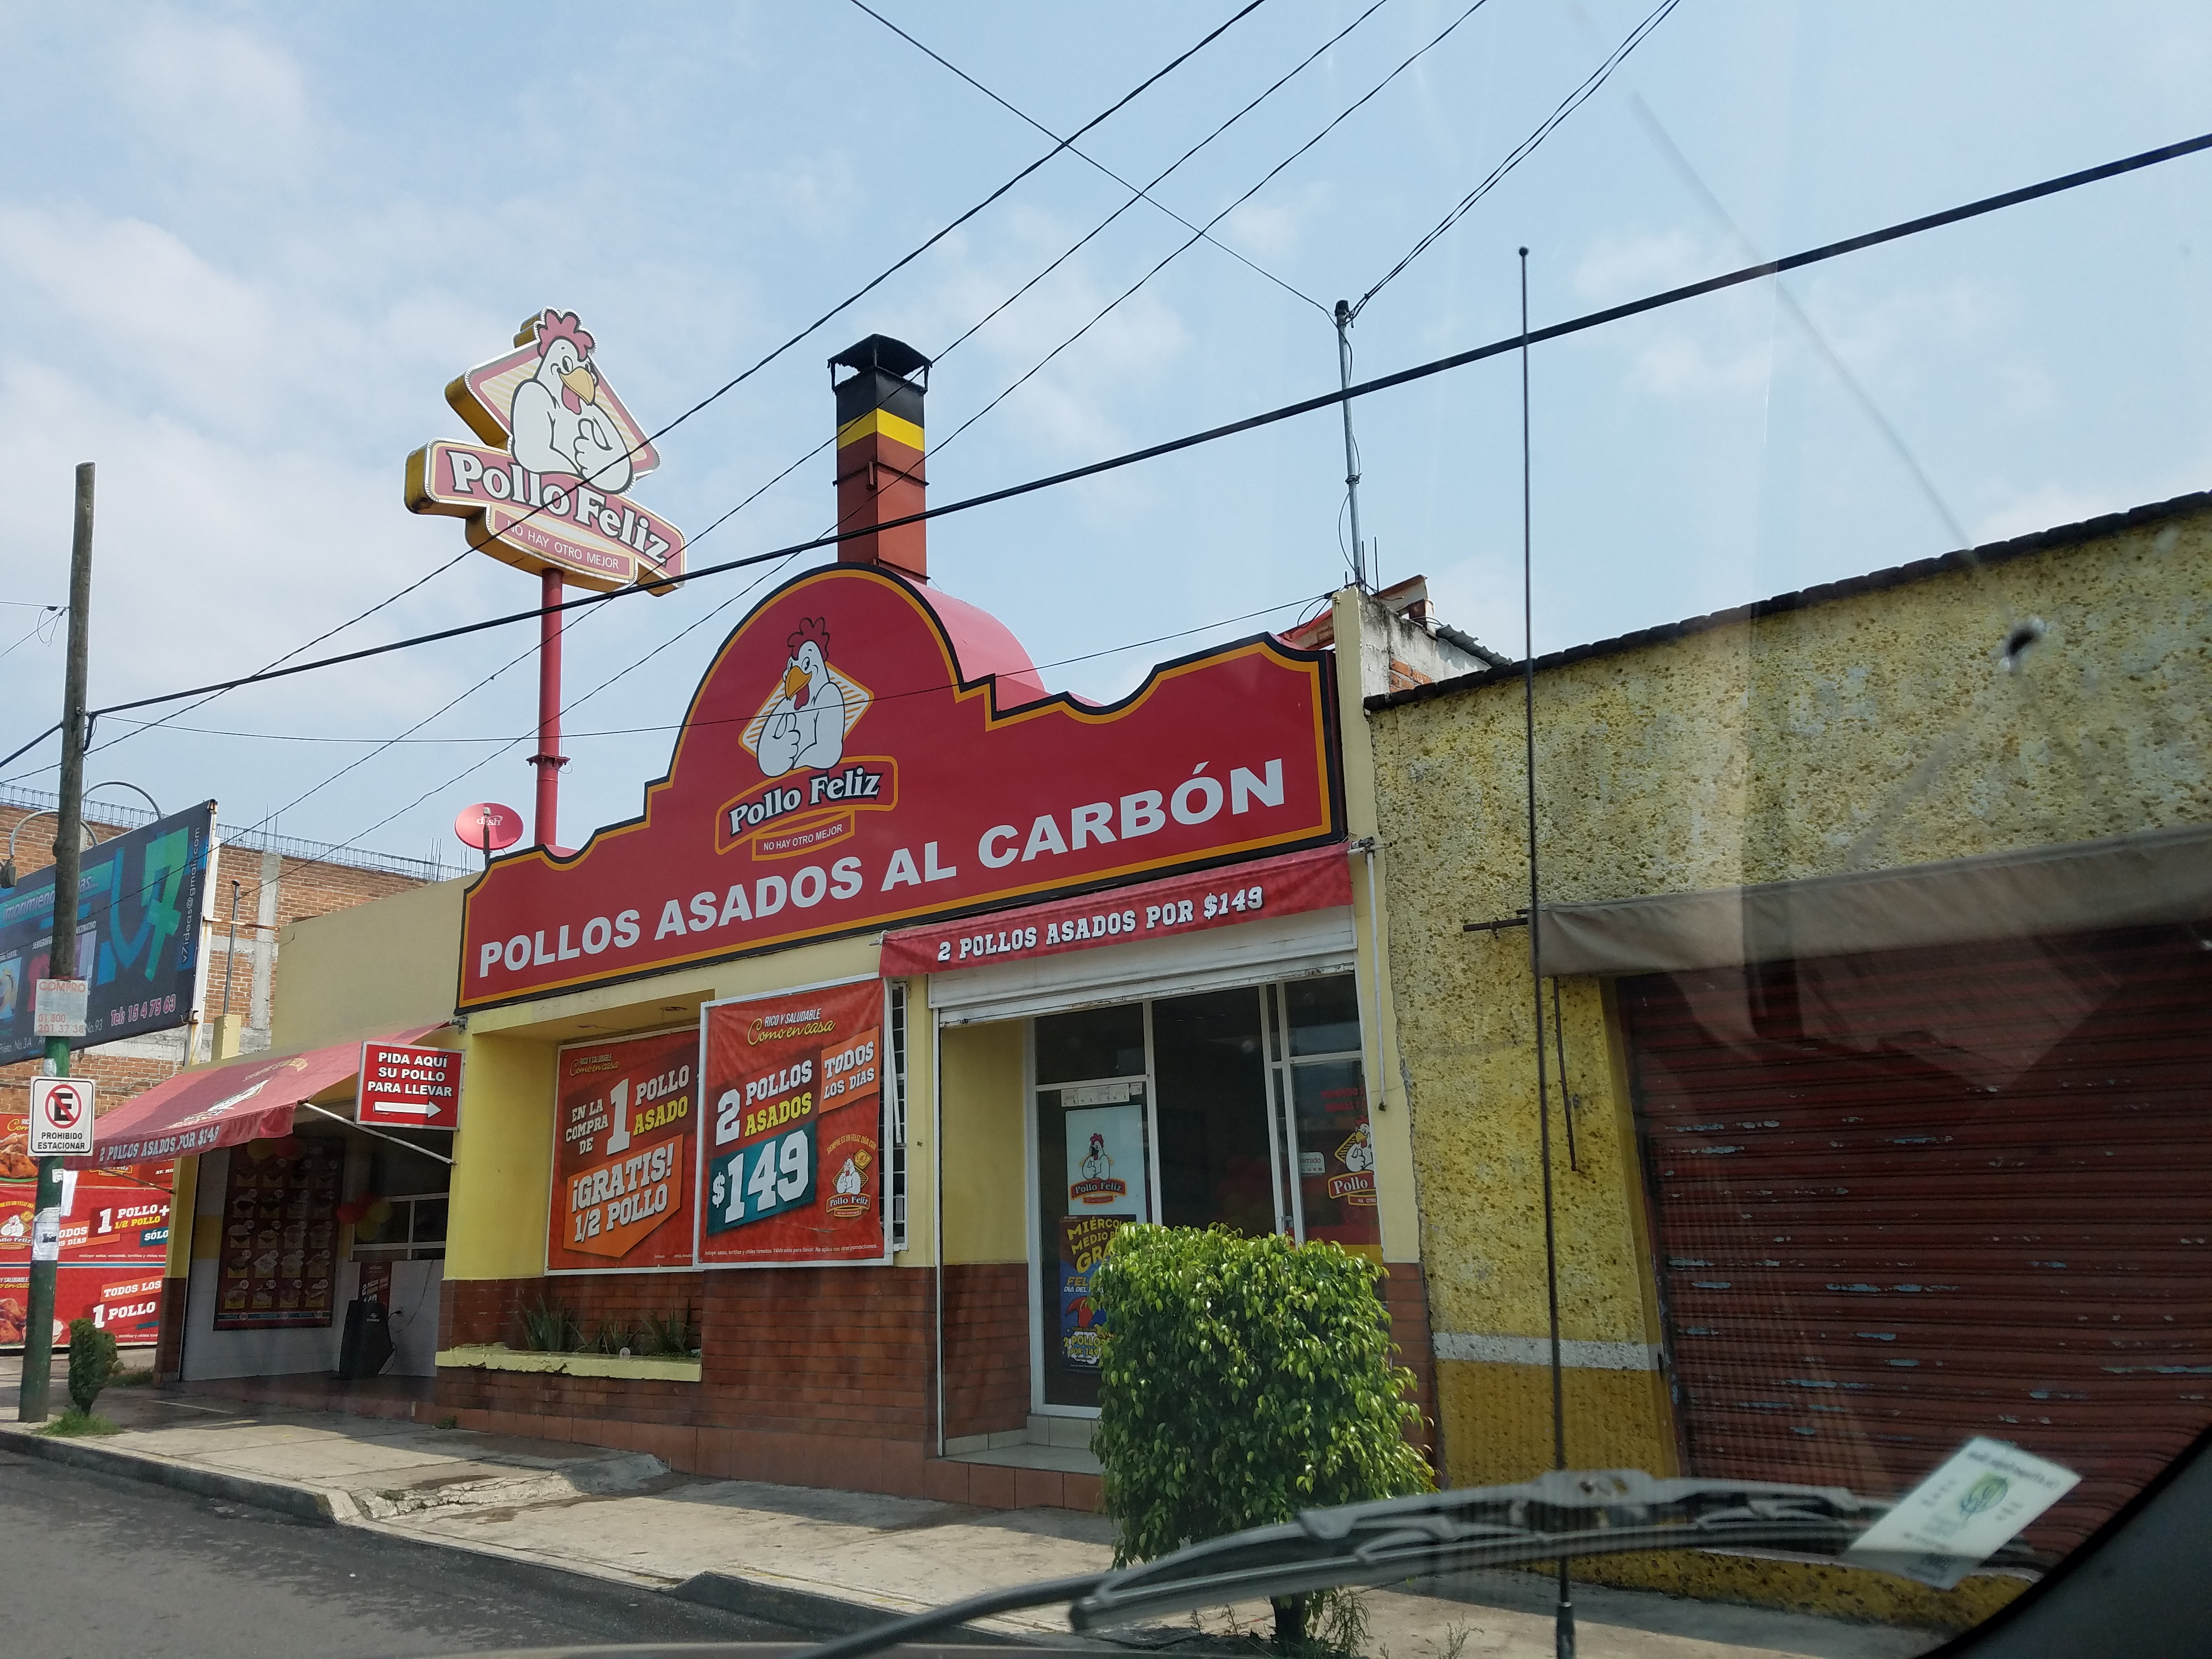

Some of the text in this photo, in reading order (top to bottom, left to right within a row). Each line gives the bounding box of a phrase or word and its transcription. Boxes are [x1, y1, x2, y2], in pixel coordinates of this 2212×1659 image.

[447, 450, 670, 567] Pollo Feliz
[507, 520, 619, 569] NO HAY OTRO MEJOR
[729, 766, 883, 837] Pollo Feliz
[763, 824, 843, 851] NO HAY OTRO MEJOR
[479, 758, 1285, 978] POLLOS ASADOS AL CARBÓN
[937, 885, 1263, 962] 2 POLLOS ASADOS POR $149
[39, 981, 86, 992] COMPRO
[38, 1014, 65, 1022] 01 800
[111, 994, 176, 1026] Tel: 15 4 75 63
[764, 1008, 822, 1028] RICO Y SALUDABLE
[38, 1024, 83, 1033] 201 37 38
[747, 1018, 836, 1046] Como en casa
[378, 1052, 449, 1068] PIDA AQUÍ
[570, 1059, 592, 1076] Como
[823, 1040, 874, 1080] TODOS
[378, 1066, 445, 1082] SU POLLO
[823, 1067, 875, 1100] LOS DÍAS
[367, 1081, 453, 1097] PARA LLEVAR
[571, 1098, 603, 1123] EN LA
[606, 1064, 690, 1156] 1 POLLO
[715, 1059, 812, 1147] 2 POLLOS
[744, 1092, 812, 1137] ASADOS
[7, 1119, 29, 1131] Com
[566, 1114, 608, 1143] COMPRA
[633, 1096, 689, 1136] ASADO
[99, 1125, 220, 1162] 2 POLLOS ASADOS POR $149
[579, 1136, 594, 1155] DE
[826, 1138, 842, 1154] SIEMPRE
[861, 1136, 869, 1146] DÍA
[571, 1142, 674, 1213] ¡GRATIS!
[712, 1129, 809, 1223] $149
[1075, 1181, 1122, 1194] Pollo Feliz
[1333, 1176, 1368, 1195] Pollo
[574, 1183, 668, 1243] 1/2 POLLO
[830, 1196, 868, 1207] Pollo Feliz
[98, 1207, 112, 1234] 1
[117, 1204, 158, 1219] POLLO
[114, 1215, 161, 1229] 1/2 POLLO
[1067, 1216, 1119, 1241] MIÉRCO
[59, 1227, 88, 1238] ODOS
[67, 1237, 87, 1246] DÍAS
[144, 1229, 168, 1241] SÓLO
[1071, 1231, 1108, 1255] MEDIO
[104, 1280, 161, 1298] TODOS LOS
[1066, 1276, 1089, 1286] FEL
[93, 1301, 156, 1329] 1 POLLO
[1063, 1336, 1069, 1347] 2
